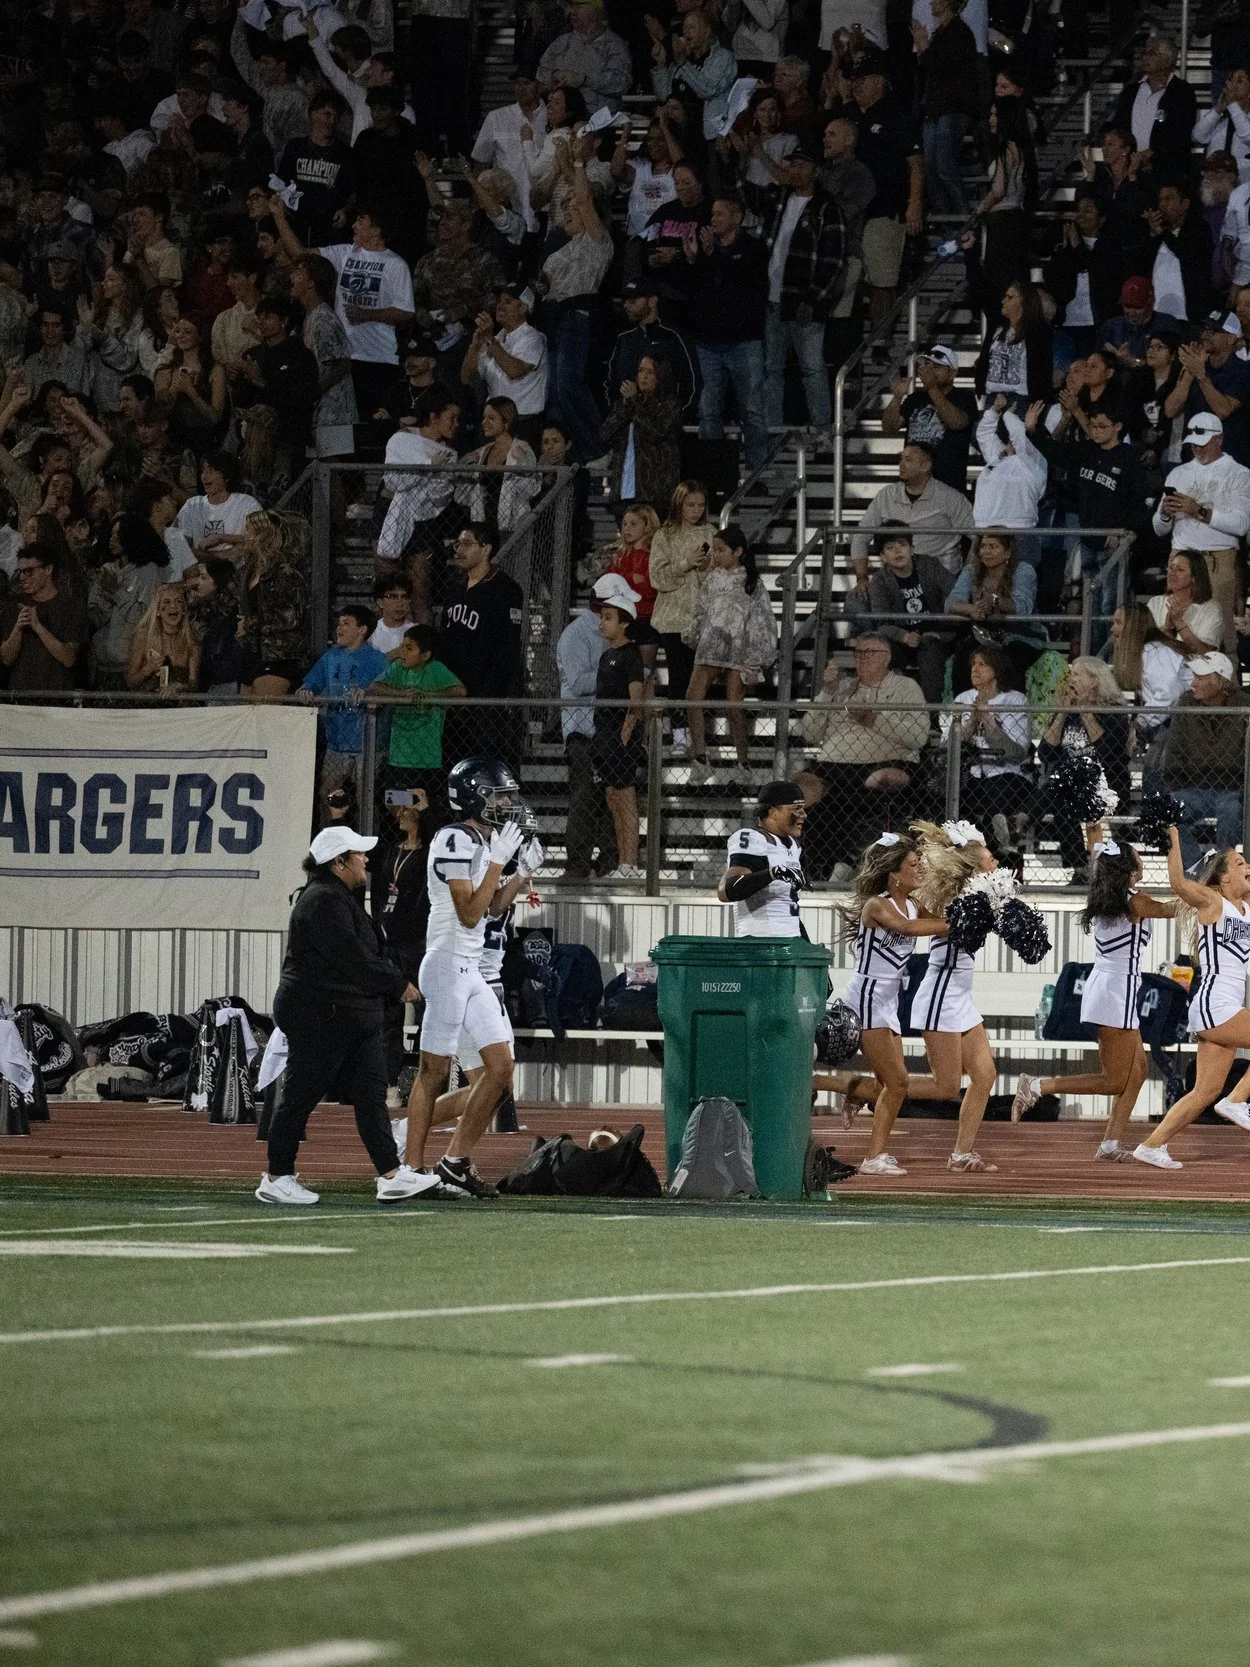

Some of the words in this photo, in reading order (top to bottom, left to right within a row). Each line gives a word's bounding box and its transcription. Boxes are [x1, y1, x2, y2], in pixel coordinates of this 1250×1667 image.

[296, 157, 342, 179] CHAMPION
[345, 258, 386, 273] CHAMPION
[0, 772, 264, 855] ARGERS
[446, 834, 456, 852] 4
[740, 832, 750, 849] 5
